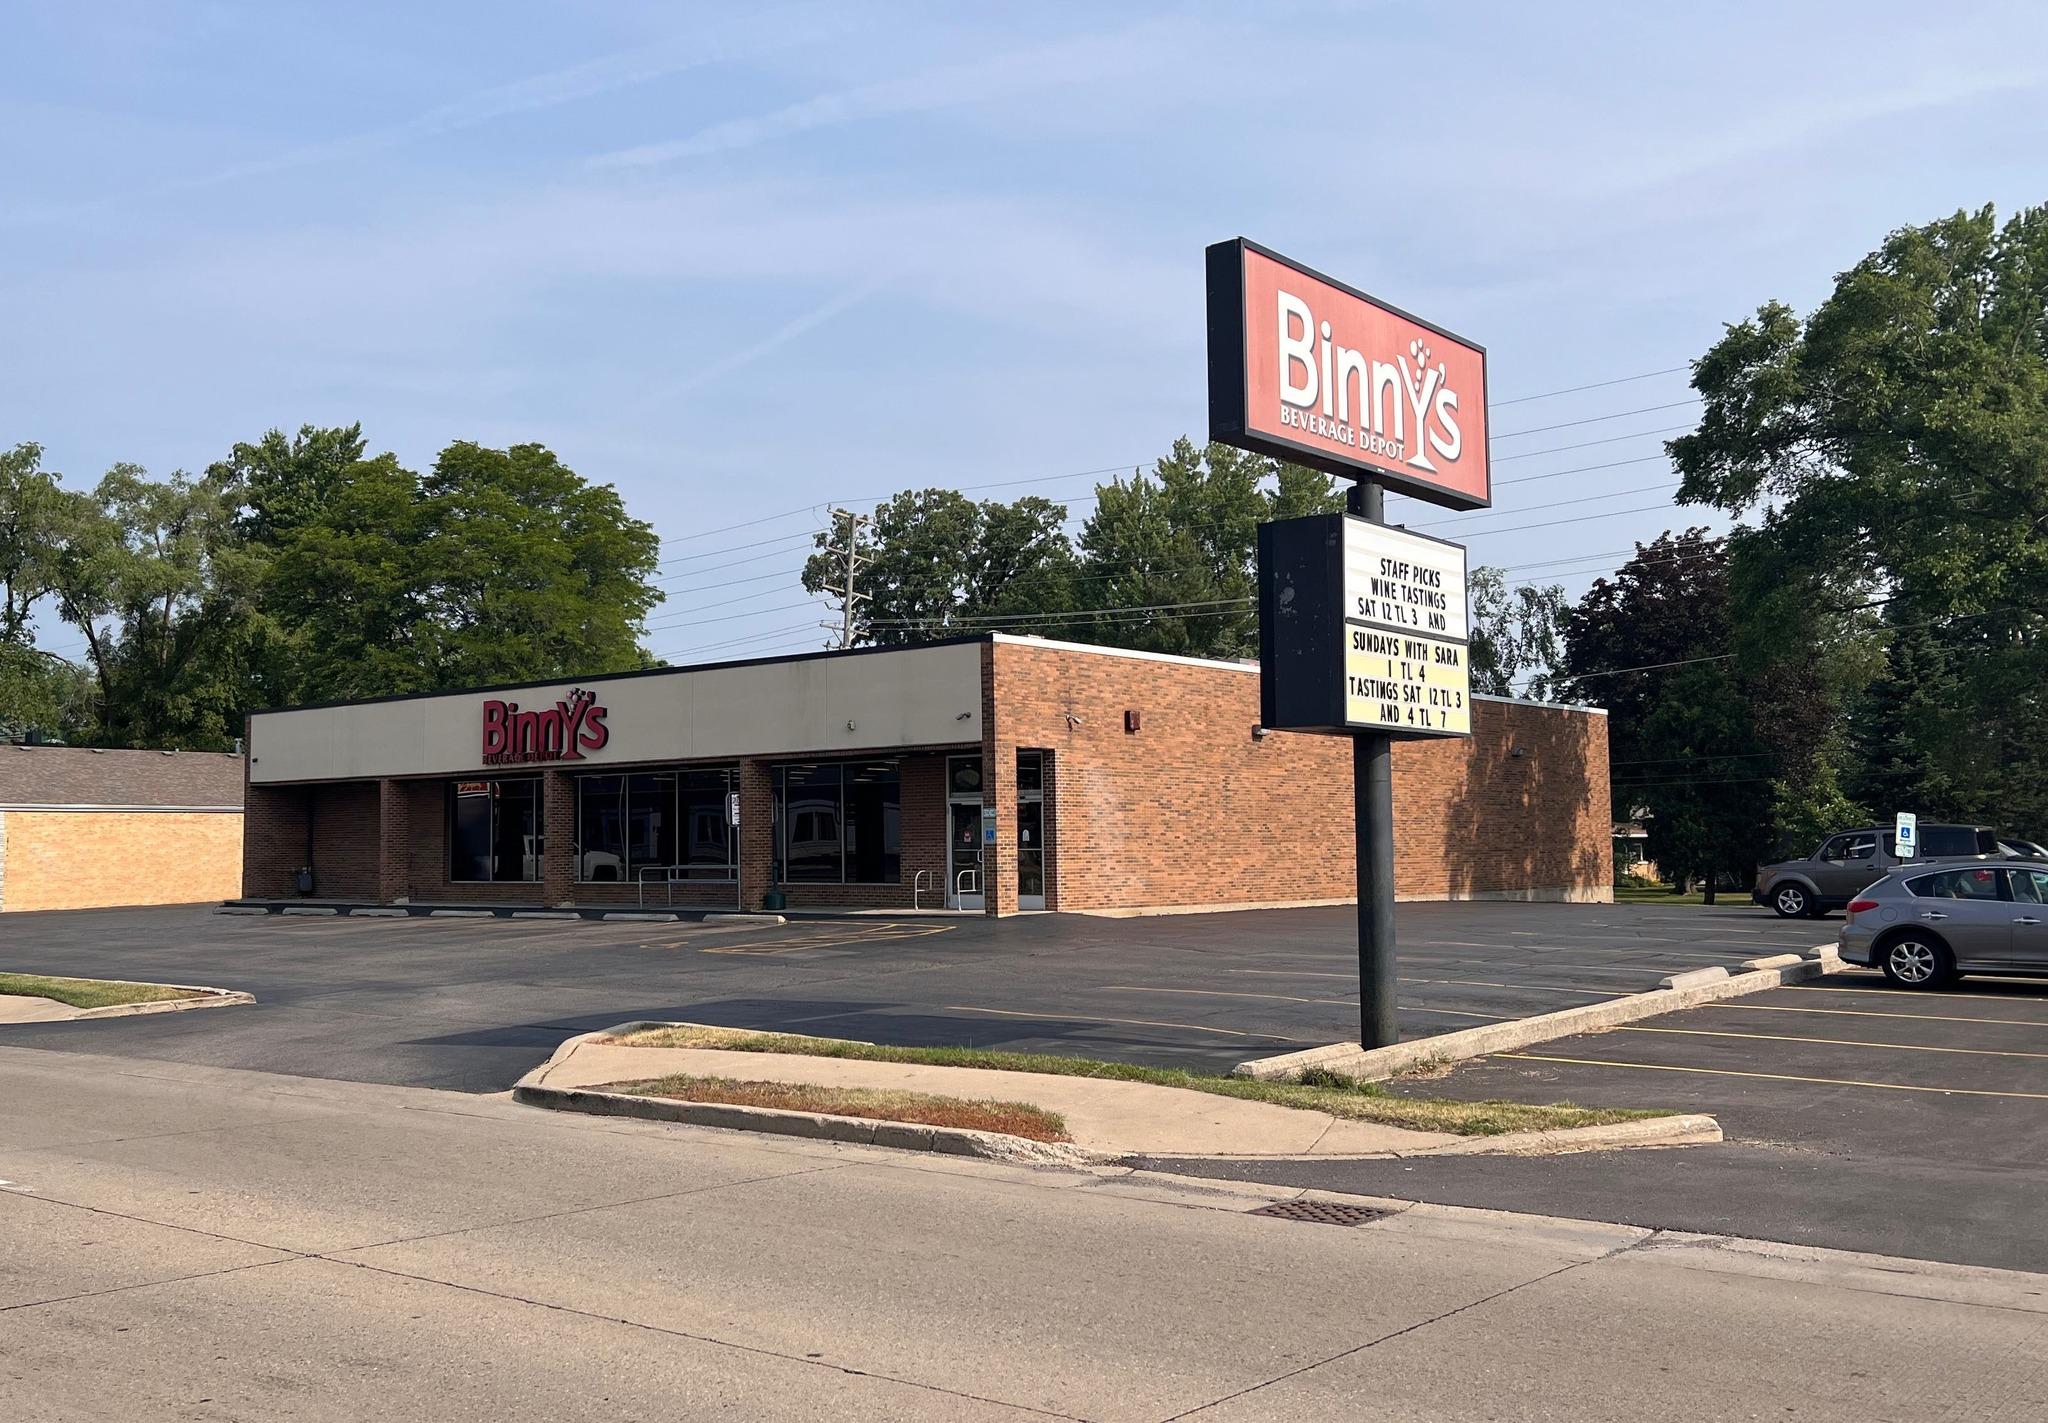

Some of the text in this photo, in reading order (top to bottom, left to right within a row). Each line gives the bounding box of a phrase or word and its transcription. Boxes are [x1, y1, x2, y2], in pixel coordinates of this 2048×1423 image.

[1280, 404, 1405, 462] BEVERAGE DEPOT
[1380, 557, 1441, 589] STAFF PICKS
[1370, 576, 1446, 611] WINE TASTINGS
[1358, 597, 1446, 631] SAT 12 TL 3 AND
[1353, 630, 1459, 667] SUNDAYS WITH SARA
[1401, 661, 1413, 681] TL
[1419, 664, 1425, 682] 4
[1349, 676, 1462, 709] TASTINGS SAT 12 TL 3
[1380, 703, 1446, 728] AND 4 TL 7
